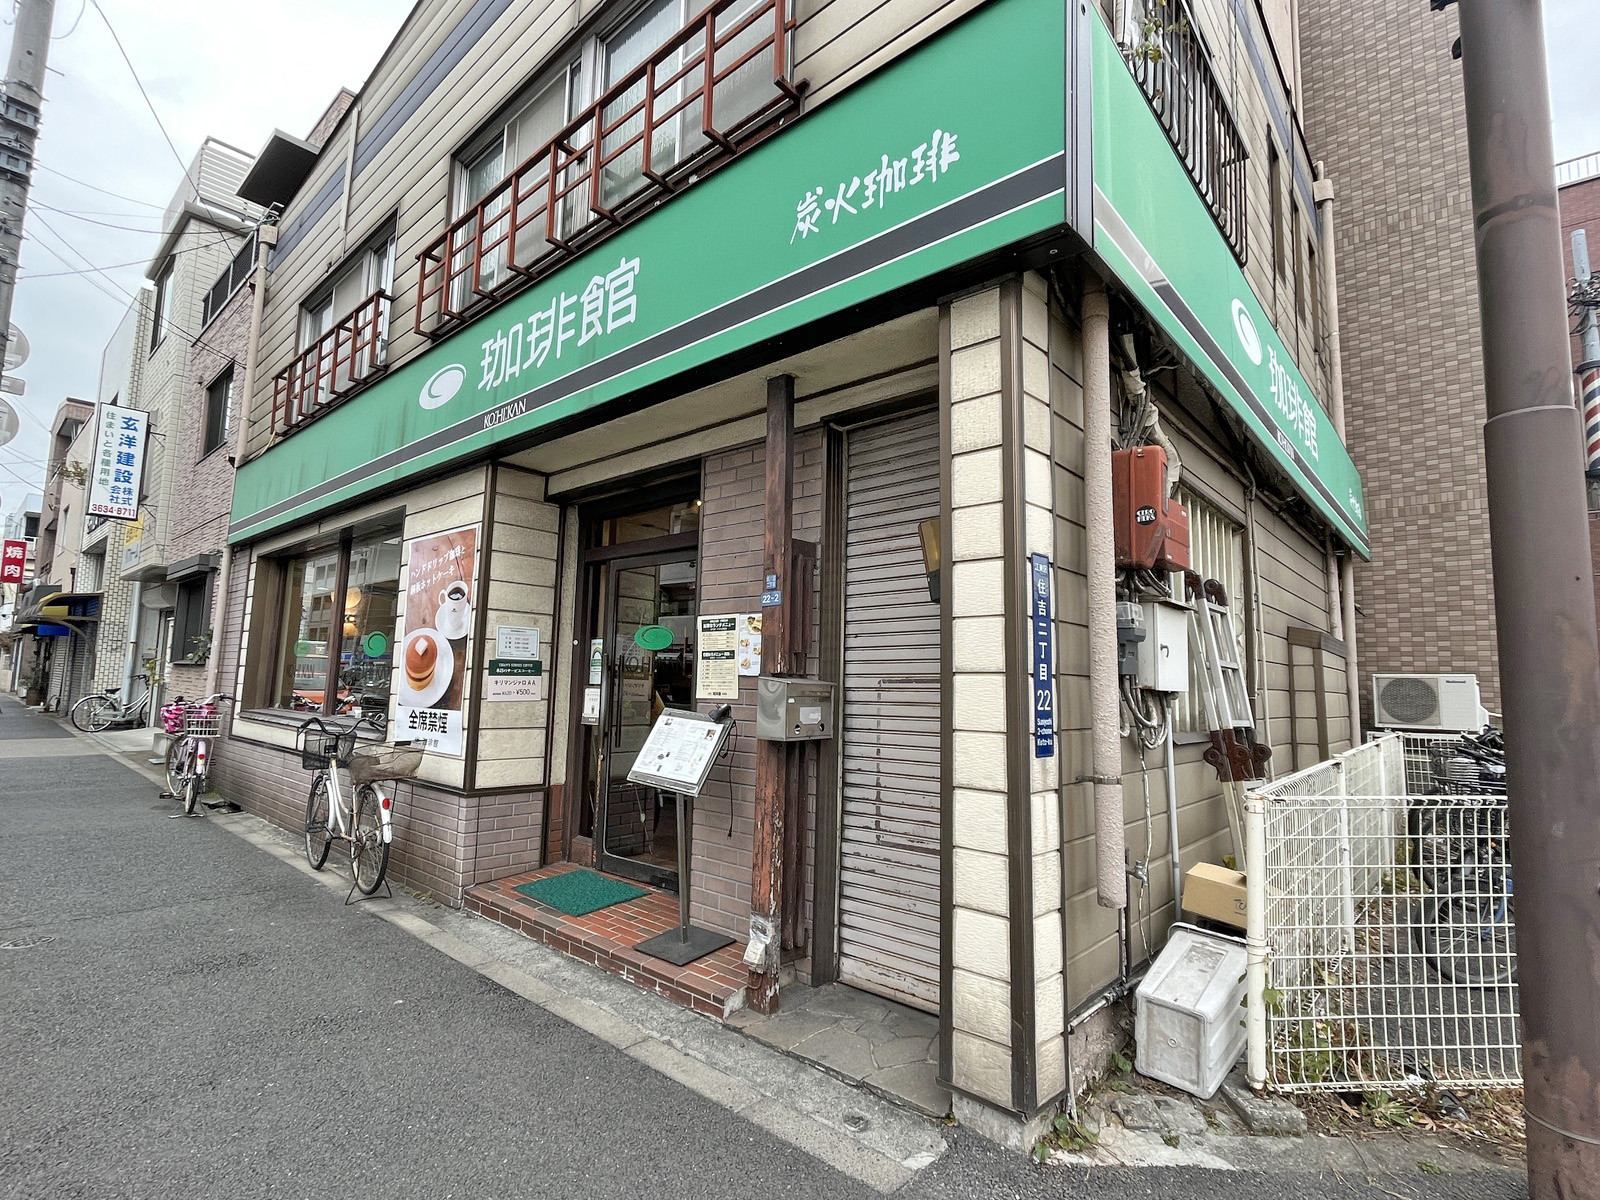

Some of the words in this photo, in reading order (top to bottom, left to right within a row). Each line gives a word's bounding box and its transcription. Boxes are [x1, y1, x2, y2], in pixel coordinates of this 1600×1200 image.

[789, 129, 960, 245] 炭火珈琲
[478, 257, 640, 391] 珈琲館
[483, 398, 527, 429] KOHIKAN
[1267, 344, 1319, 461] 珈琲館
[114, 416, 140, 484] 玄洋建設
[4, 545, 24, 578] 焼肉
[762, 593, 779, 604] 22-2
[1037, 578, 1048, 681] 住吉二丁目
[408, 709, 449, 734] 全席禁煙
[1037, 689, 1051, 711] 22
